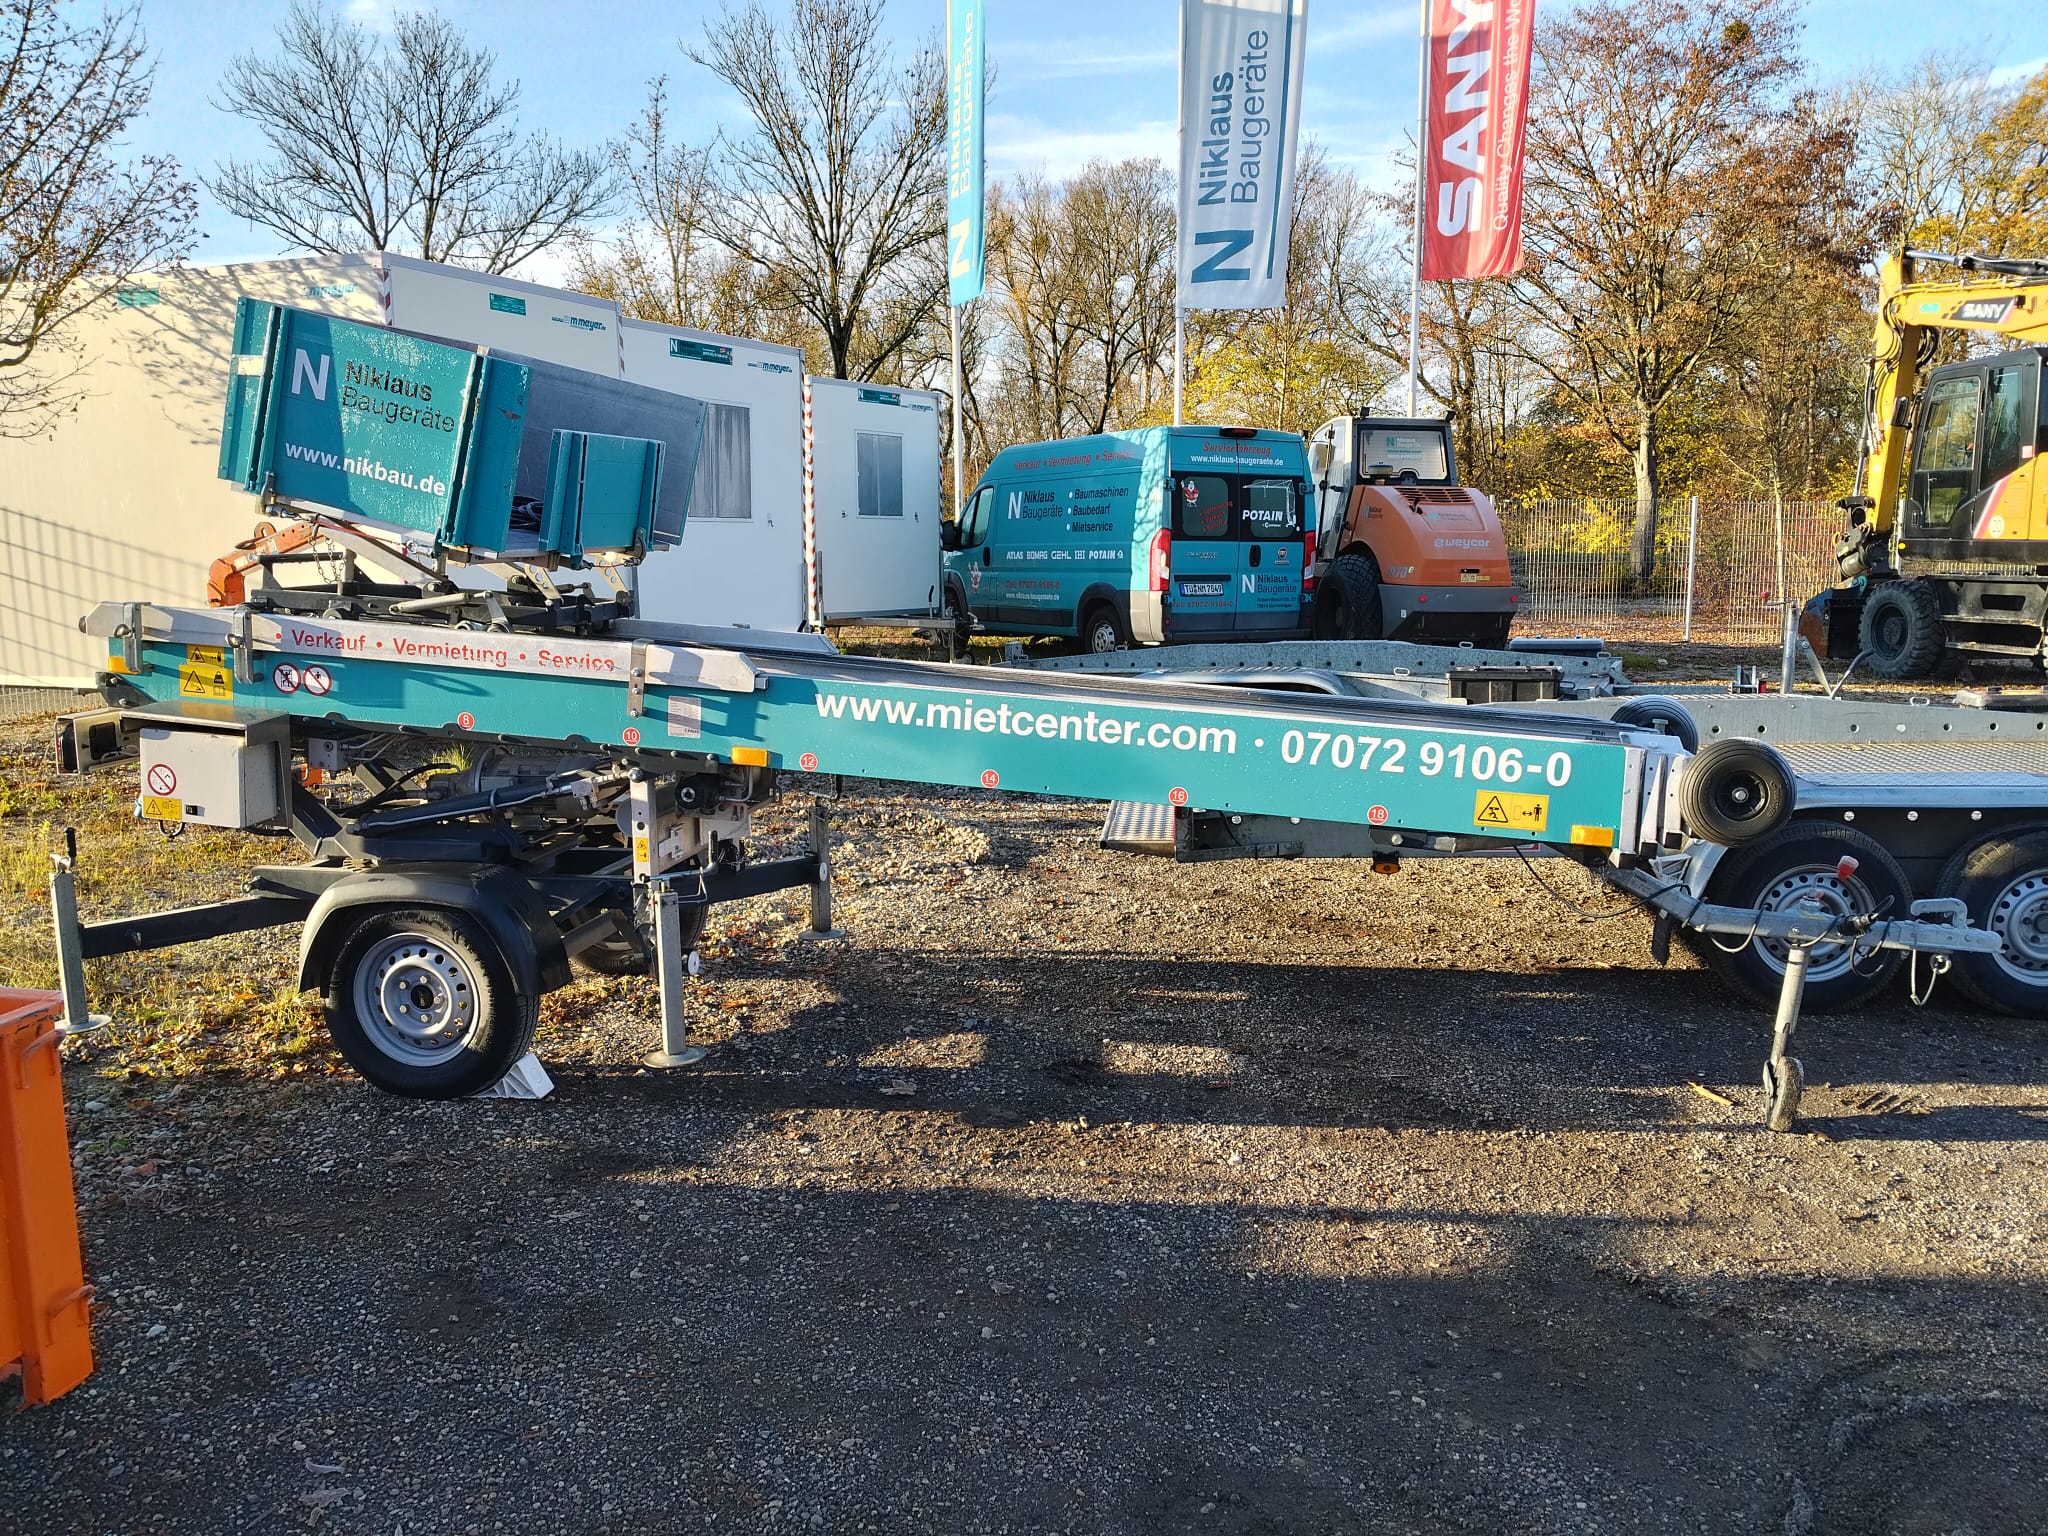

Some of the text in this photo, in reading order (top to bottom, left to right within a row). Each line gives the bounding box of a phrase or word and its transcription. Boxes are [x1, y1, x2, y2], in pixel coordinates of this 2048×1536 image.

[1503, 34, 1520, 70] the
[1230, 30, 1271, 203] Baugeräte
[1437, 0, 1494, 237] SANY
[1496, 77, 1519, 156] Changes
[951, 61, 962, 199] Niklaus
[1197, 71, 1234, 206] Niklaus
[1493, 165, 1513, 230] Quality
[951, 217, 970, 279] N
[1191, 229, 1254, 283] N
[1962, 303, 2006, 319] SANY
[291, 348, 330, 401] N
[345, 360, 433, 401] Niklaus
[342, 385, 455, 433] Baugeräte
[285, 442, 446, 496] www.nikbau.de
[1048, 453, 1092, 468] Vermietung
[1023, 490, 1055, 504] Niklaus
[1074, 486, 1129, 500] Baumaschinen
[1008, 491, 1022, 520] N
[1022, 504, 1063, 522] Baugeräte
[1072, 503, 1111, 517] Baubedarf
[1242, 508, 1283, 522] POTAIN
[1071, 520, 1114, 533] Mietservice
[1445, 538, 1490, 549] weycor
[1006, 550, 1024, 560] ATLAS
[1026, 550, 1048, 560] BOMAG
[1051, 550, 1071, 560] GEHL
[1088, 549, 1116, 560] POTAIN
[1242, 574, 1255, 593] N
[1257, 574, 1289, 583] Niklaus
[1257, 584, 1297, 595] Baugeräte
[291, 629, 615, 672] Verkauf Vermietung Service
[463, 715, 470, 725] 8
[625, 731, 638, 742] 10
[815, 694, 1572, 787] www.mietcenter.com 07072 9106-0
[803, 756, 815, 767] 12
[983, 774, 996, 784] 14
[1172, 790, 1185, 801] 16
[1370, 808, 1384, 820] 18
